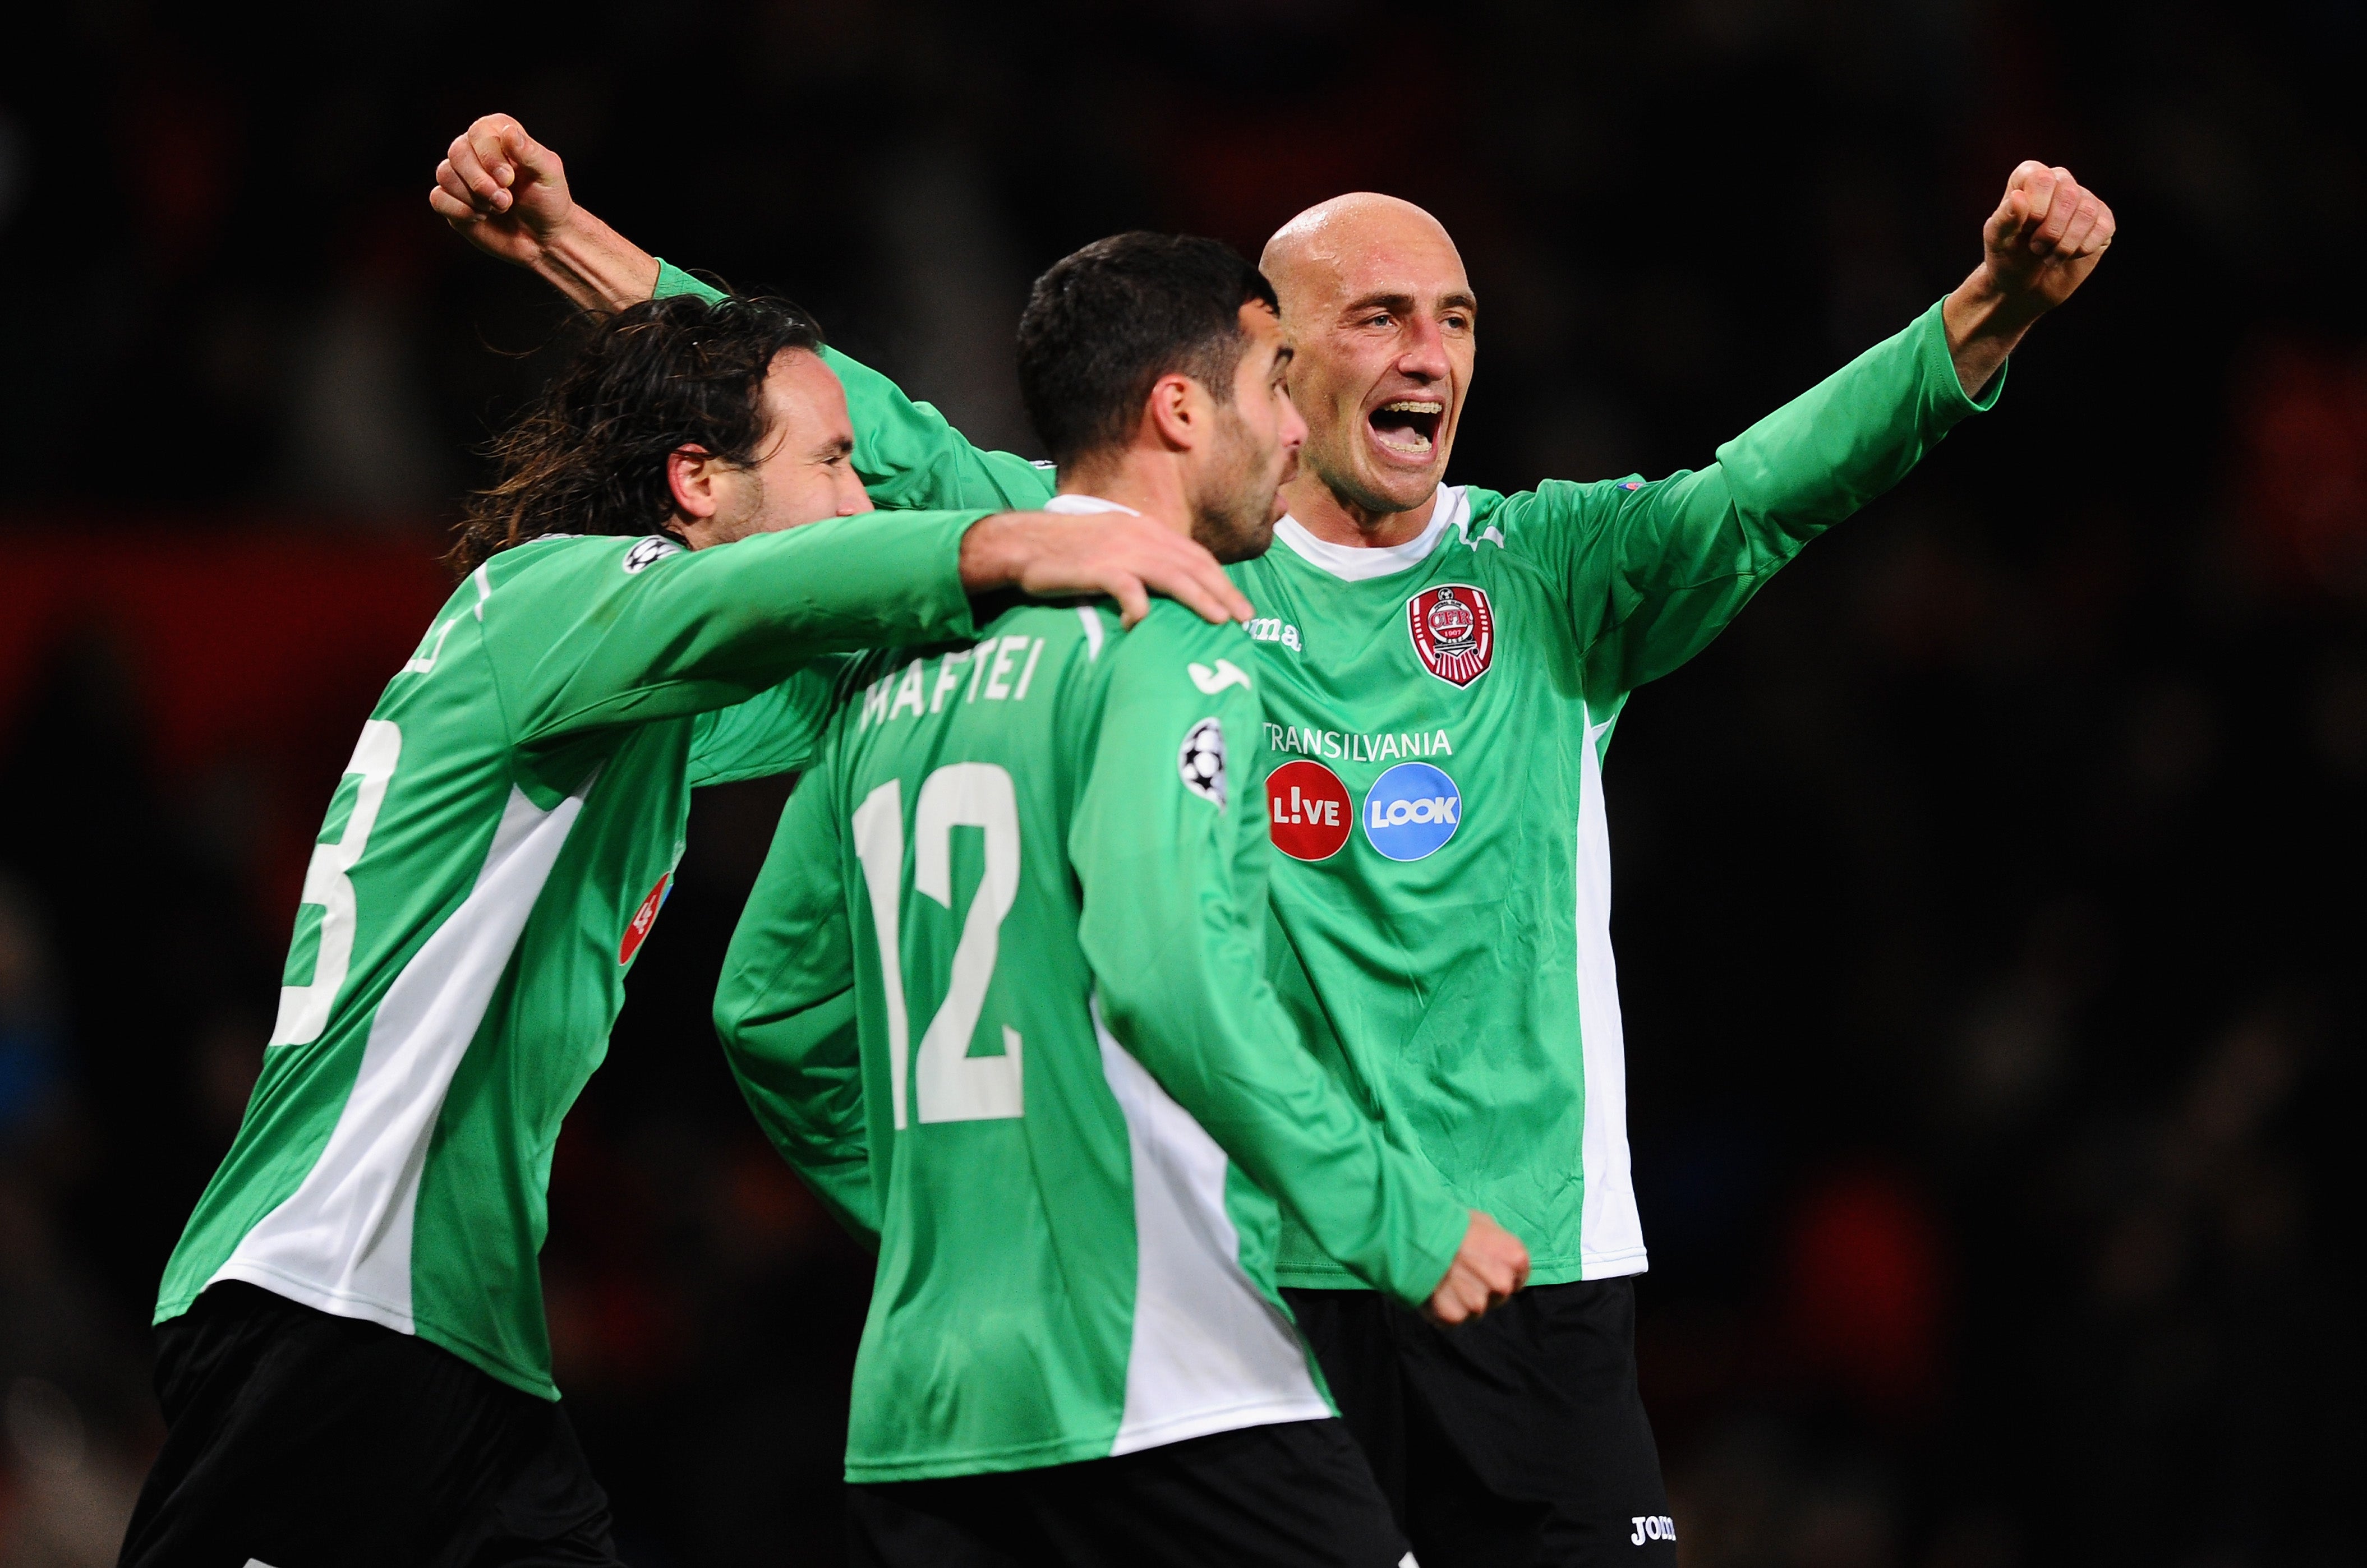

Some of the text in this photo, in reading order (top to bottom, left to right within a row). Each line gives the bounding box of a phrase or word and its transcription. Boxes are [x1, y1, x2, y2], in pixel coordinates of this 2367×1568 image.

[1242, 618, 1302, 652] ma
[1429, 609, 1472, 629] CFR
[859, 634, 1046, 734] MAFTEI
[1263, 722, 1452, 762] TRANSILVANIA
[1371, 797, 1457, 828] LOOK
[851, 761, 1025, 1130] 12
